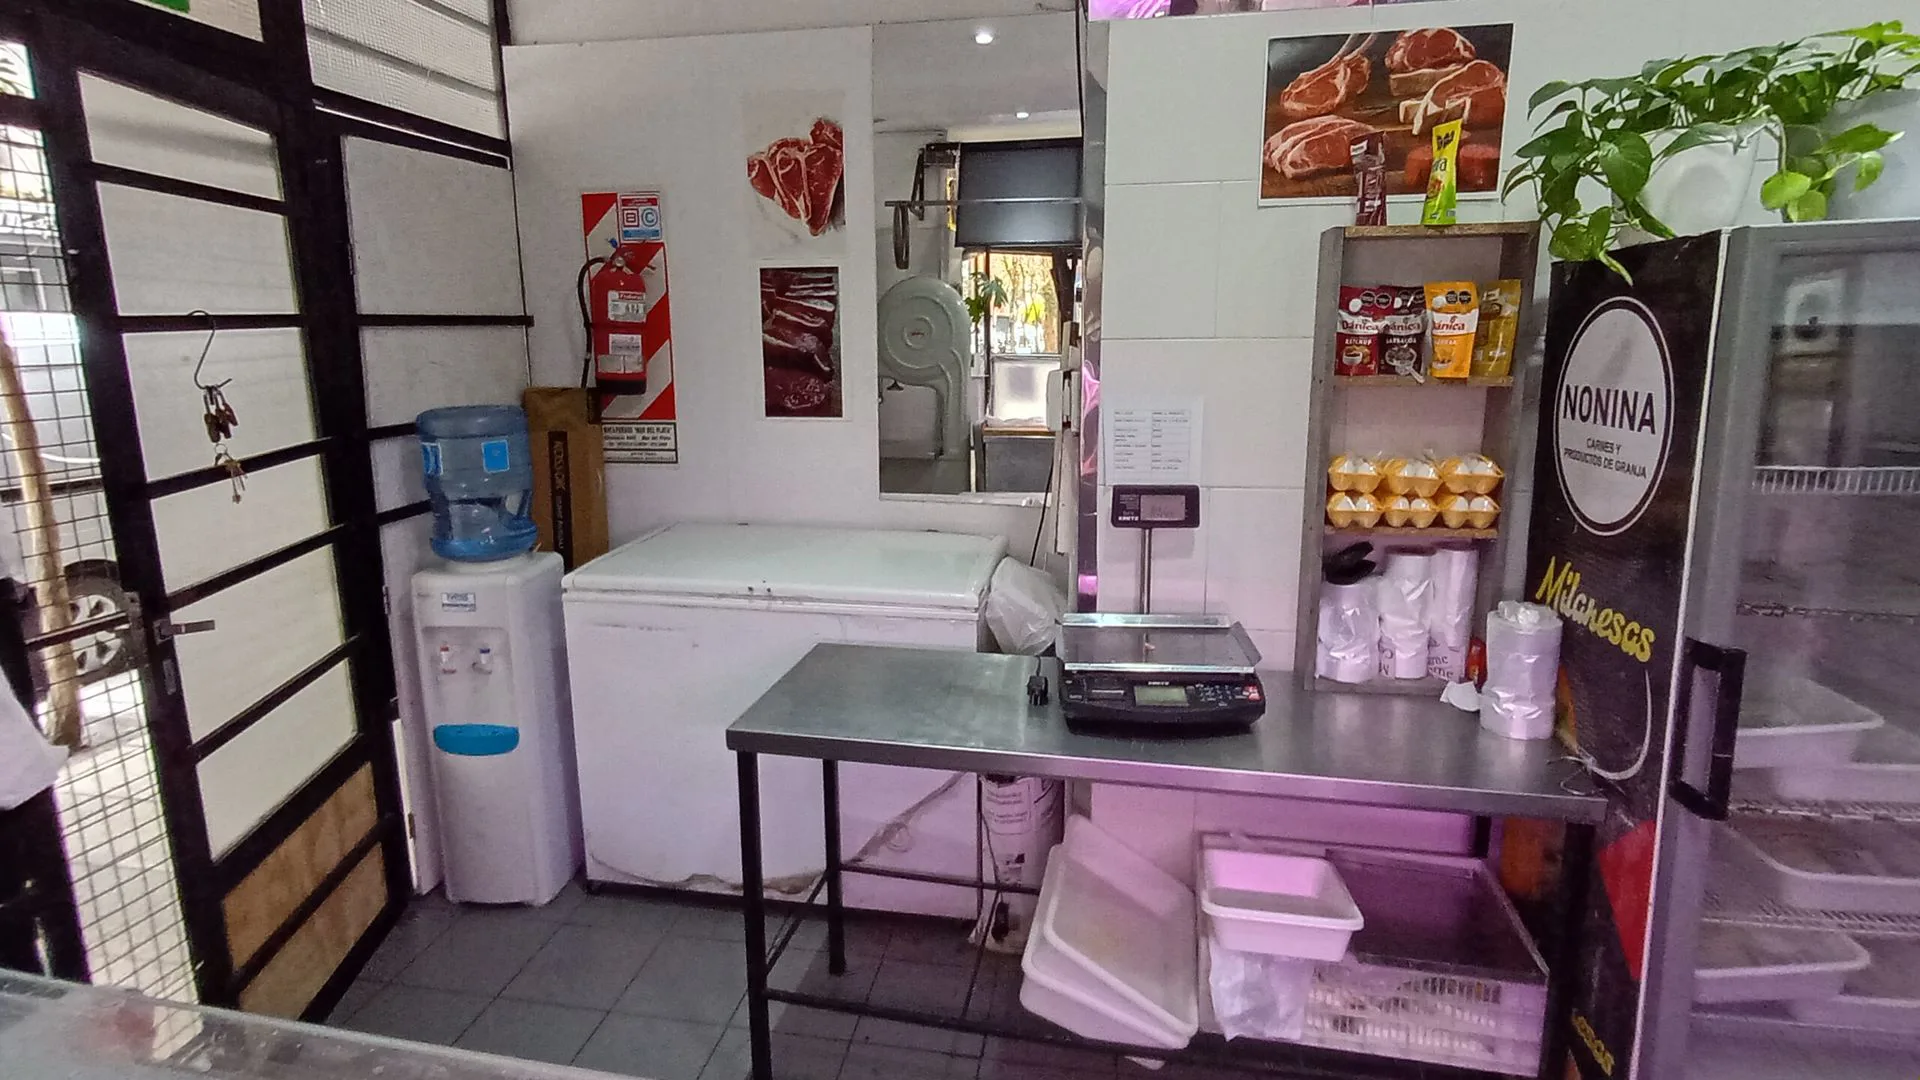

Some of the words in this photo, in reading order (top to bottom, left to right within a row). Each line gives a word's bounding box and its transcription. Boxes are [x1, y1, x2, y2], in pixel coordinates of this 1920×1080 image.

[1344, 337, 1373, 345] KETCHUP
[1562, 384, 1656, 435] NONINA
[1586, 437, 1614, 453] CARNES
[1564, 447, 1602, 469] PRODUCTOS
[1603, 458, 1615, 470] DE
[1615, 461, 1647, 479] GRANJA
[1535, 555, 1655, 662] Milanesas
